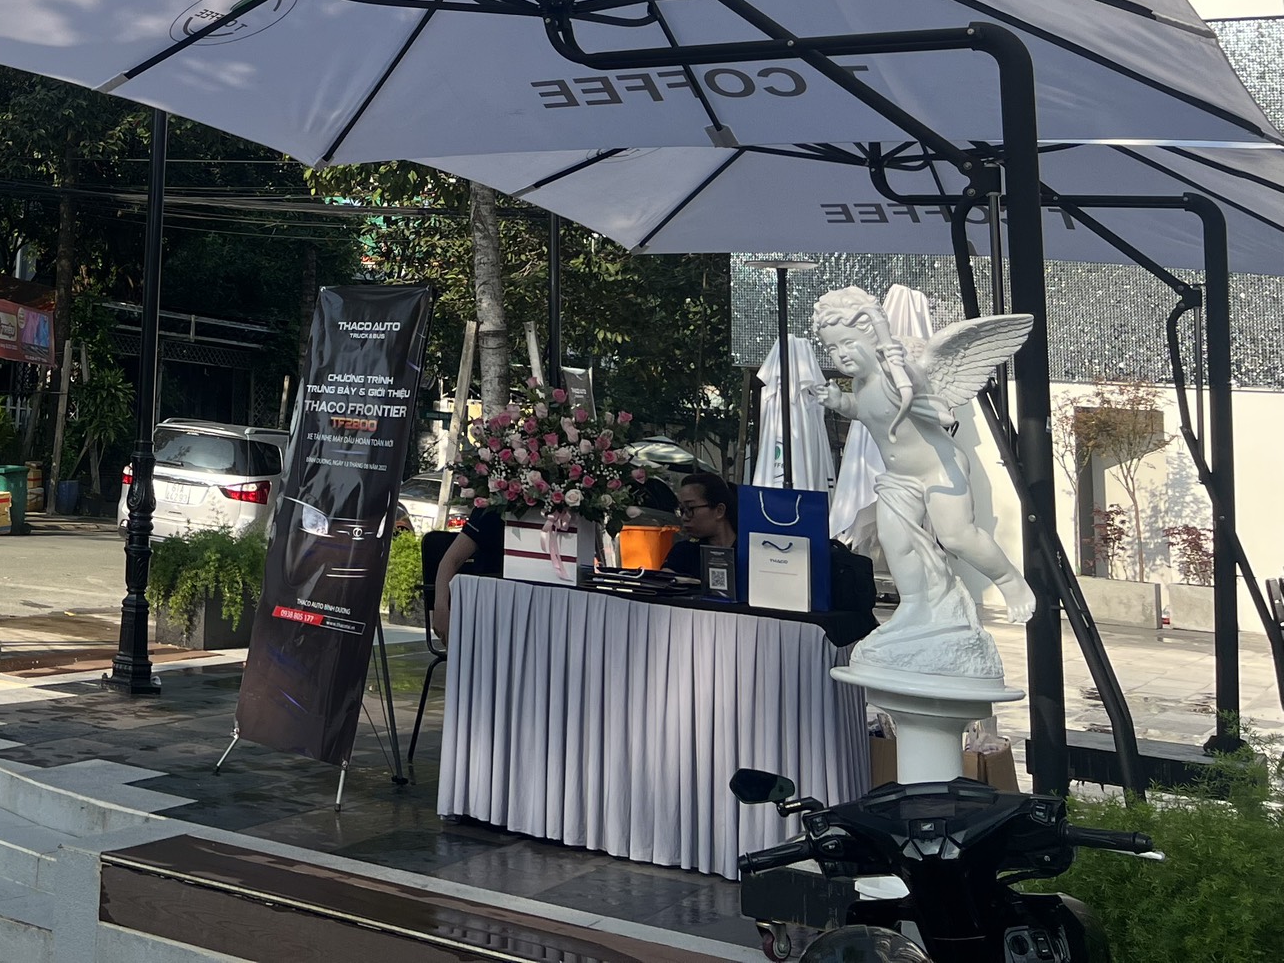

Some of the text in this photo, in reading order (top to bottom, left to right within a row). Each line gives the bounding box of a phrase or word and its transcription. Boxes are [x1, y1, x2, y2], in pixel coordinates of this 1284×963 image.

[338, 321, 401, 331] THACO AUTO
[327, 373, 394, 385] CHƯƠNG TRÌNH
[306, 384, 336, 394] TRƯNG
[337, 386, 357, 396] BÀY
[358, 388, 366, 396] &
[304, 400, 407, 417] THACO FRONTIER
[330, 416, 378, 432] TF2800
